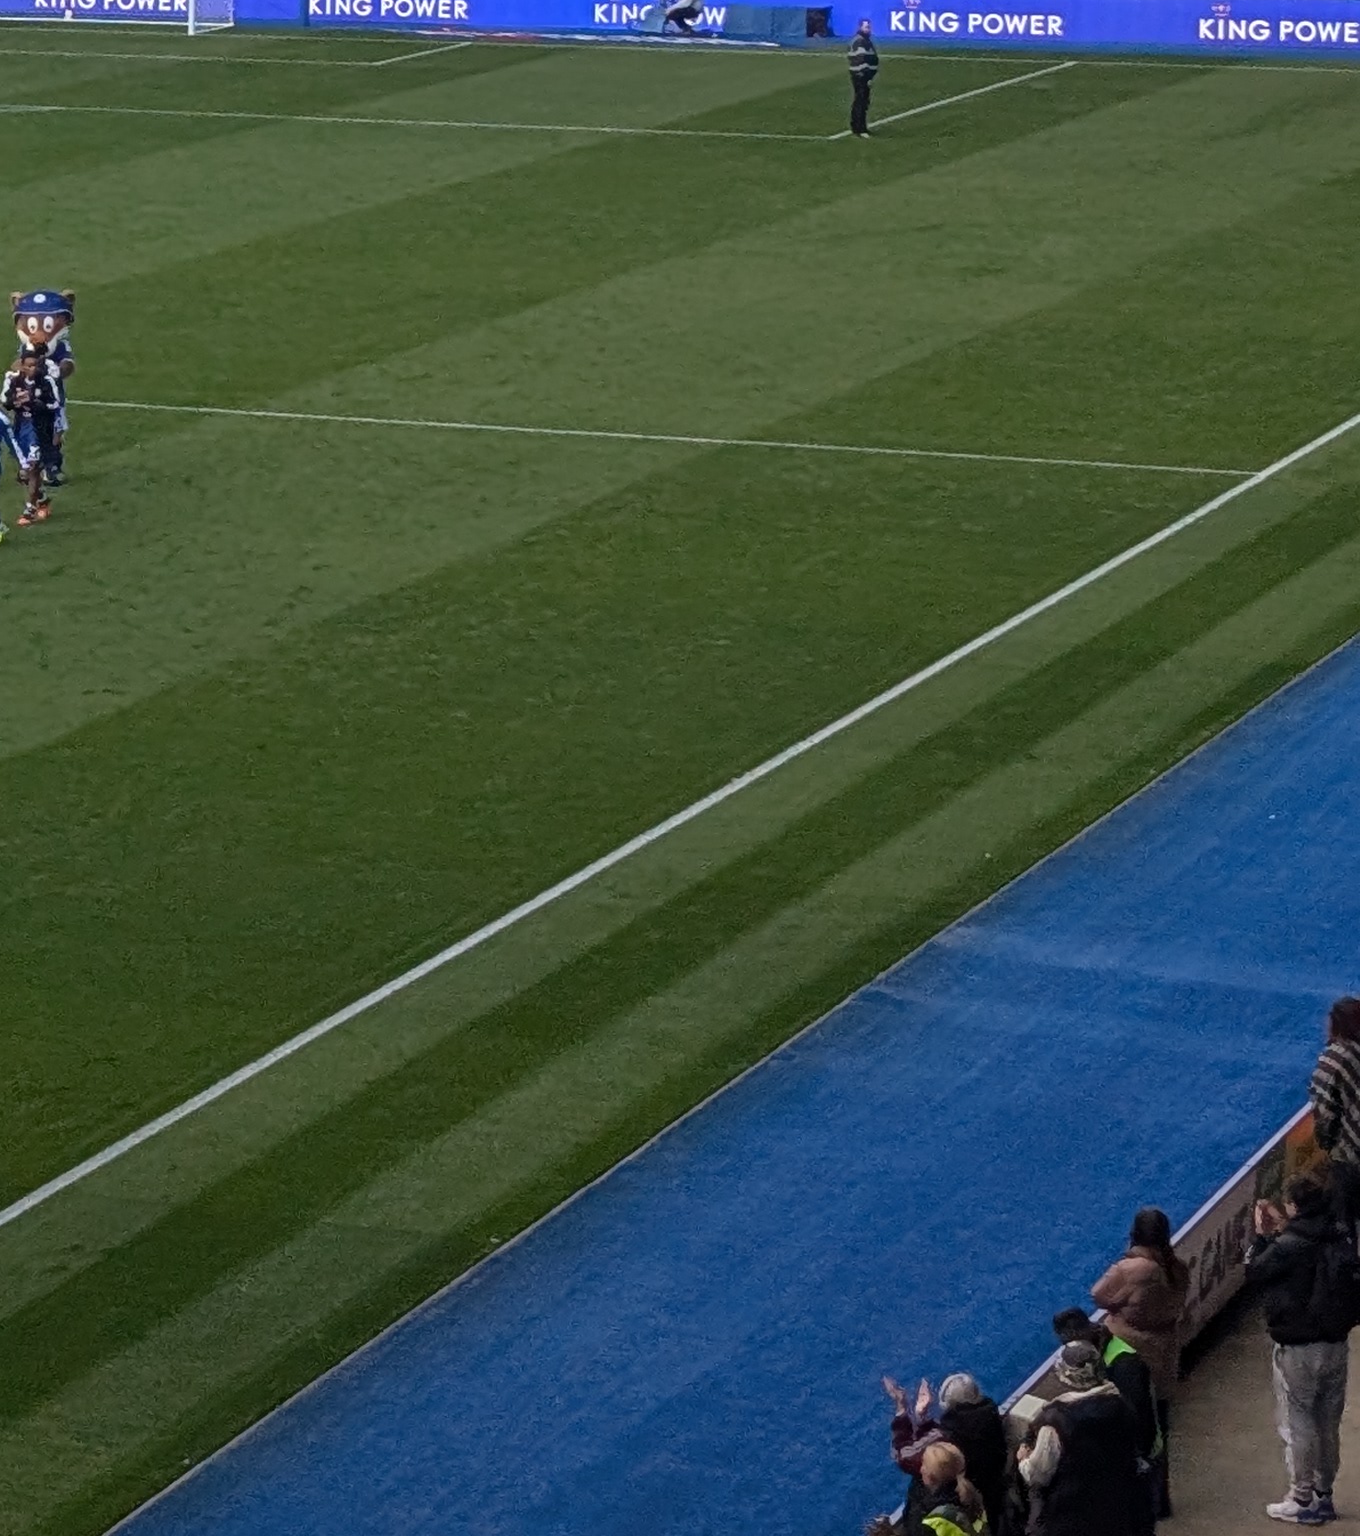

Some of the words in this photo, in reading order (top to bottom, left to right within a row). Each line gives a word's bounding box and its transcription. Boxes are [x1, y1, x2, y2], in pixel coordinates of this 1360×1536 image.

[890, 10, 959, 33] KING
[968, 14, 1064, 36] POWER
[1199, 18, 1271, 41] KING
[1279, 21, 1360, 42] POWE
